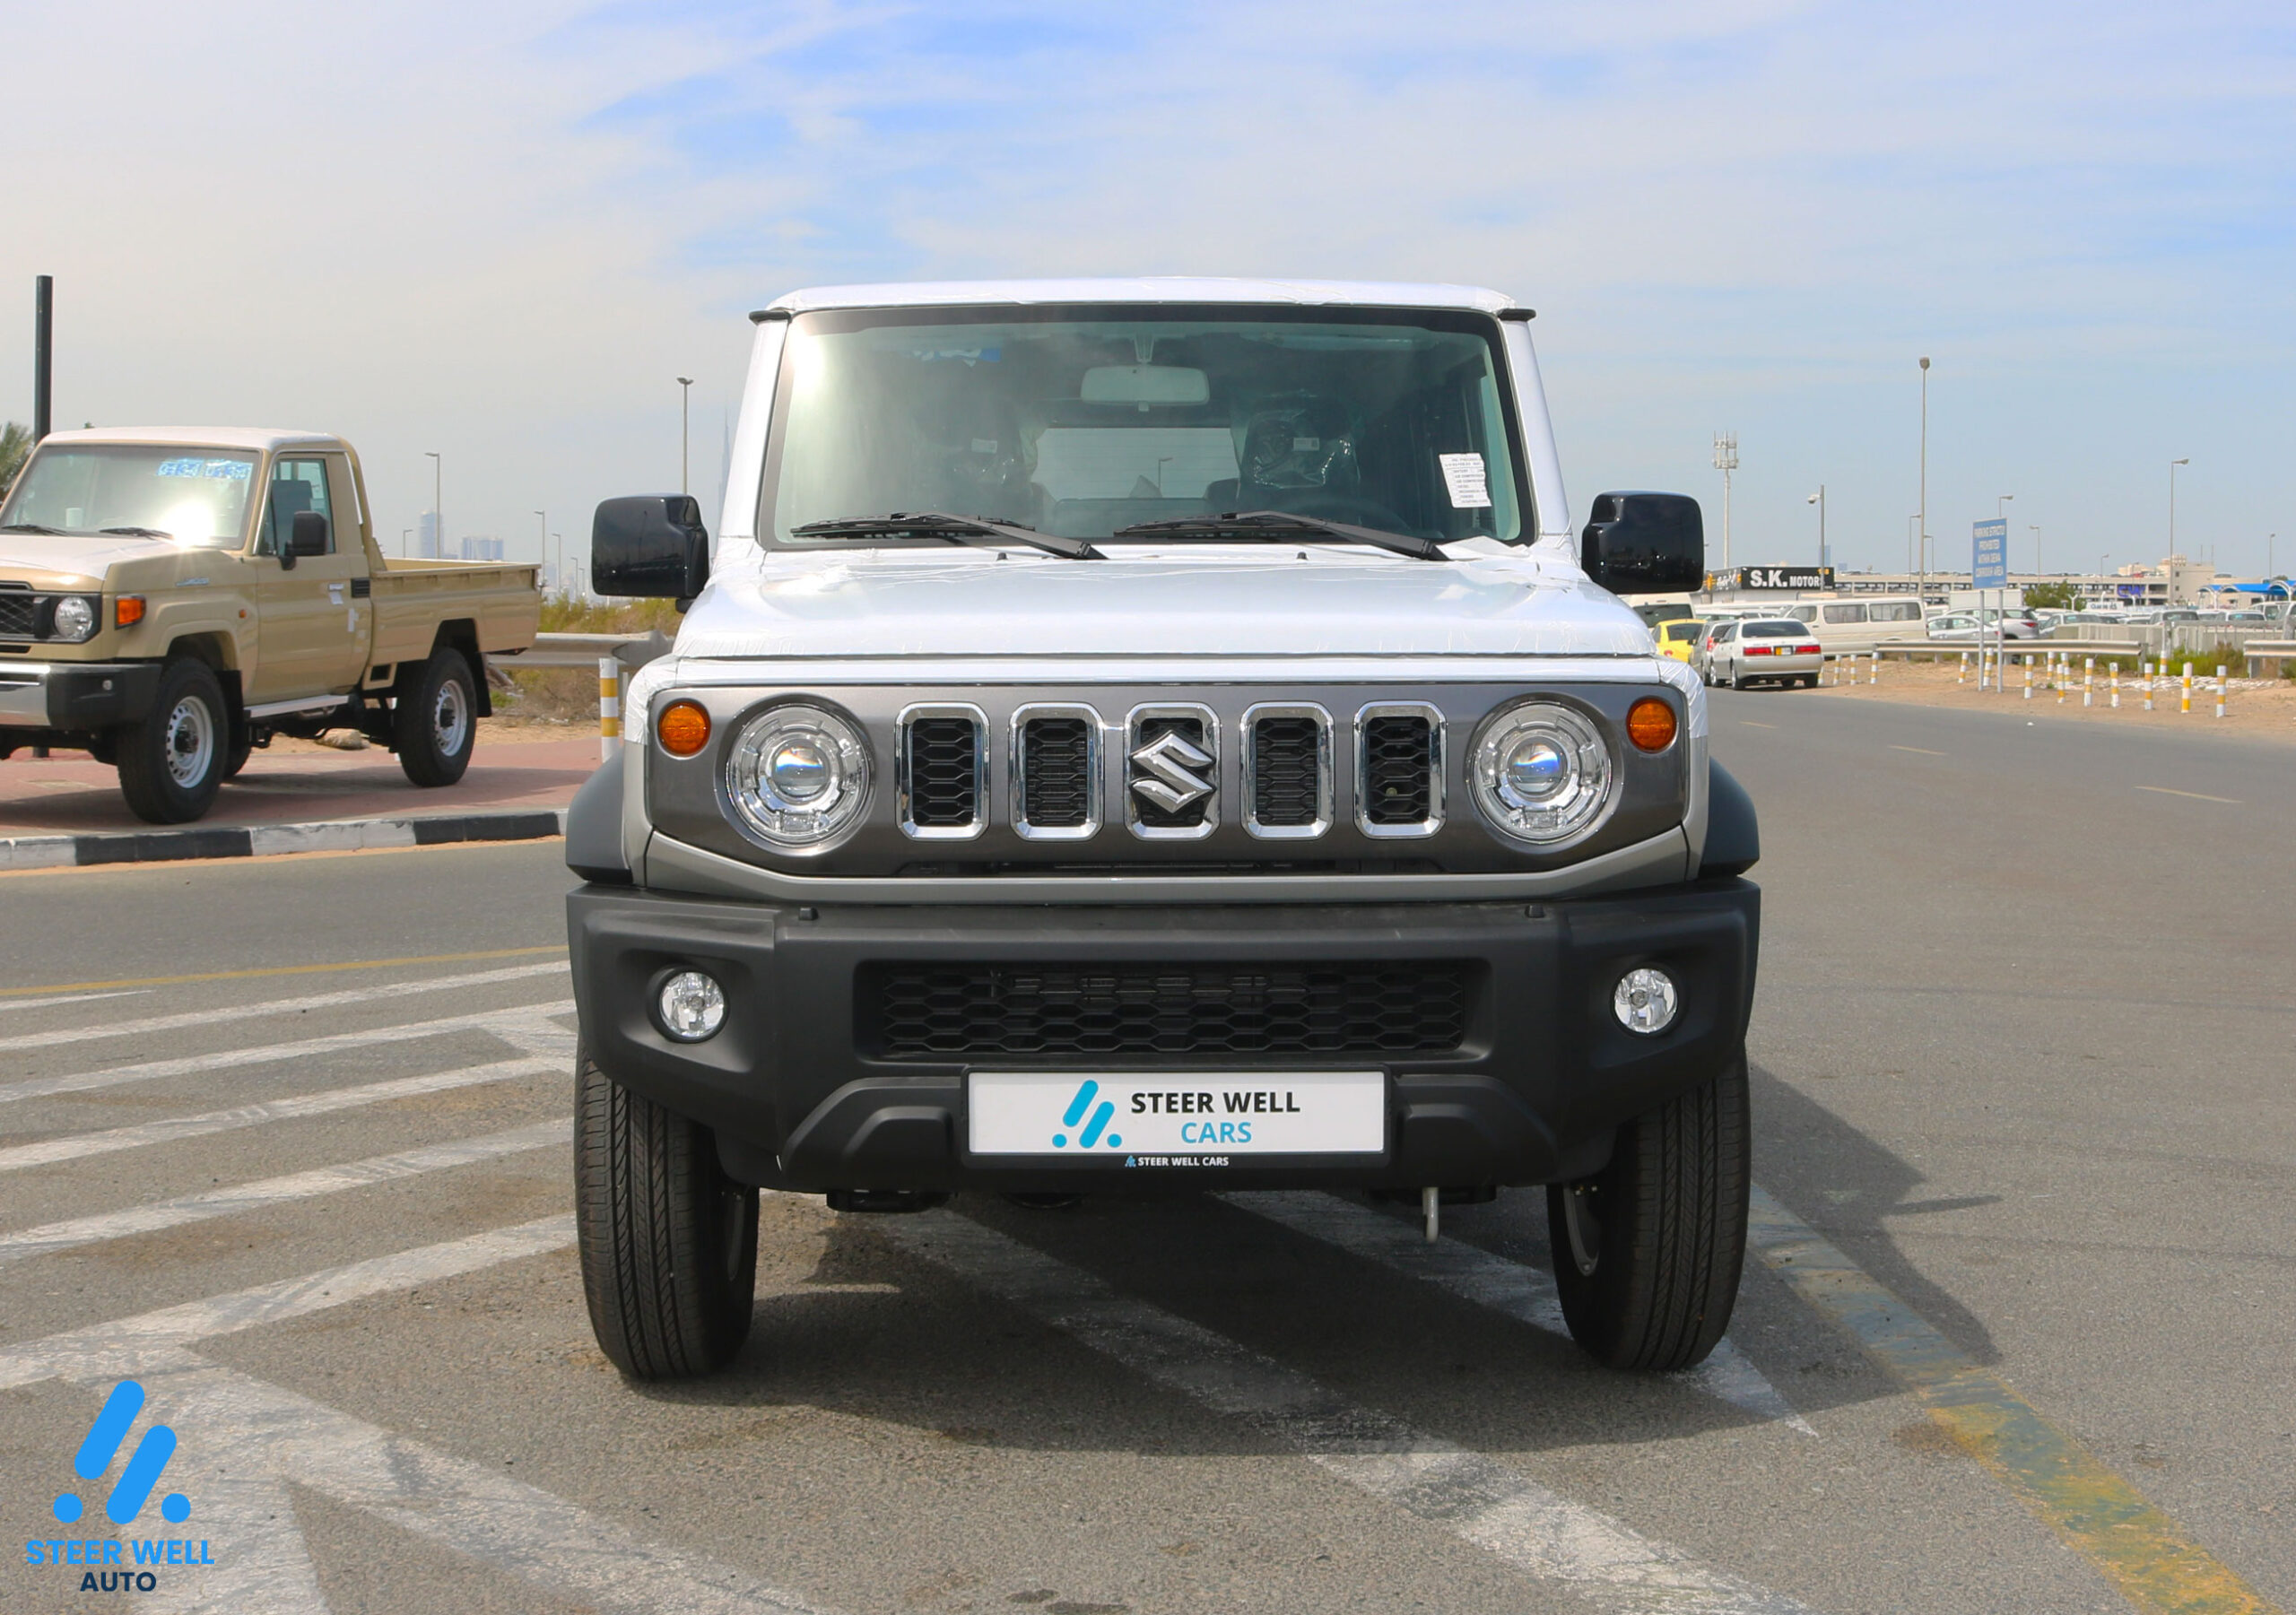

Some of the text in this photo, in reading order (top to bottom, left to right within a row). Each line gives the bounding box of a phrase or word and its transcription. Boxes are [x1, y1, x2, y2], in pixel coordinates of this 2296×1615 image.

[1750, 569, 1787, 587] S.K.
[1131, 1091, 1300, 1114] STEER WELL
[1181, 1122, 1252, 1143] CARS
[1137, 1157, 1229, 1167] STEER WELL CARS
